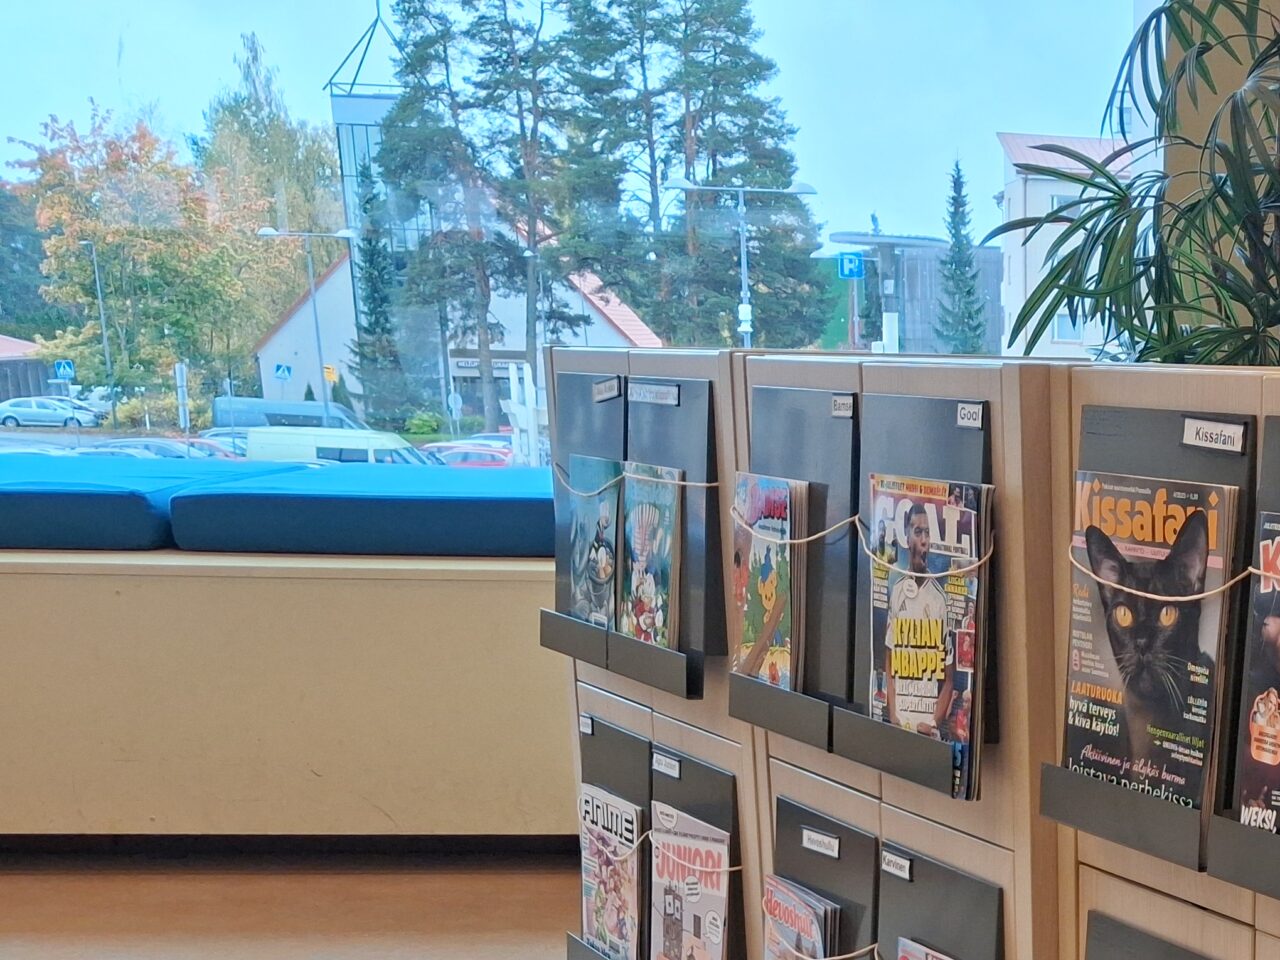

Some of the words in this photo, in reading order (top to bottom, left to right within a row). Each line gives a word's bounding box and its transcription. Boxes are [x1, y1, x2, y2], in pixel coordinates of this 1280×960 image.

[833, 399, 853, 413] Bamse
[959, 407, 980, 421] Goal
[1194, 426, 1236, 448] Kissafani
[875, 495, 971, 549] GOAL
[1074, 478, 1220, 551] Kissafai
[1071, 681, 1123, 705] LAATURUOKA
[1069, 696, 1087, 712] hyvä
[1089, 701, 1116, 720] terveys
[1067, 713, 1074, 725] &
[1074, 713, 1090, 729] kiva
[1091, 717, 1120, 737] käytös!
[1080, 743, 1121, 767] Aktiivinen
[1120, 756, 1130, 775] ja
[1132, 758, 1160, 780] älykäs
[1161, 764, 1186, 786] burma
[582, 793, 635, 846] ANIME
[1240, 805, 1277, 834] WEKSI,
[655, 841, 723, 891] JUNIORI
[882, 854, 907, 873] Karvinen
